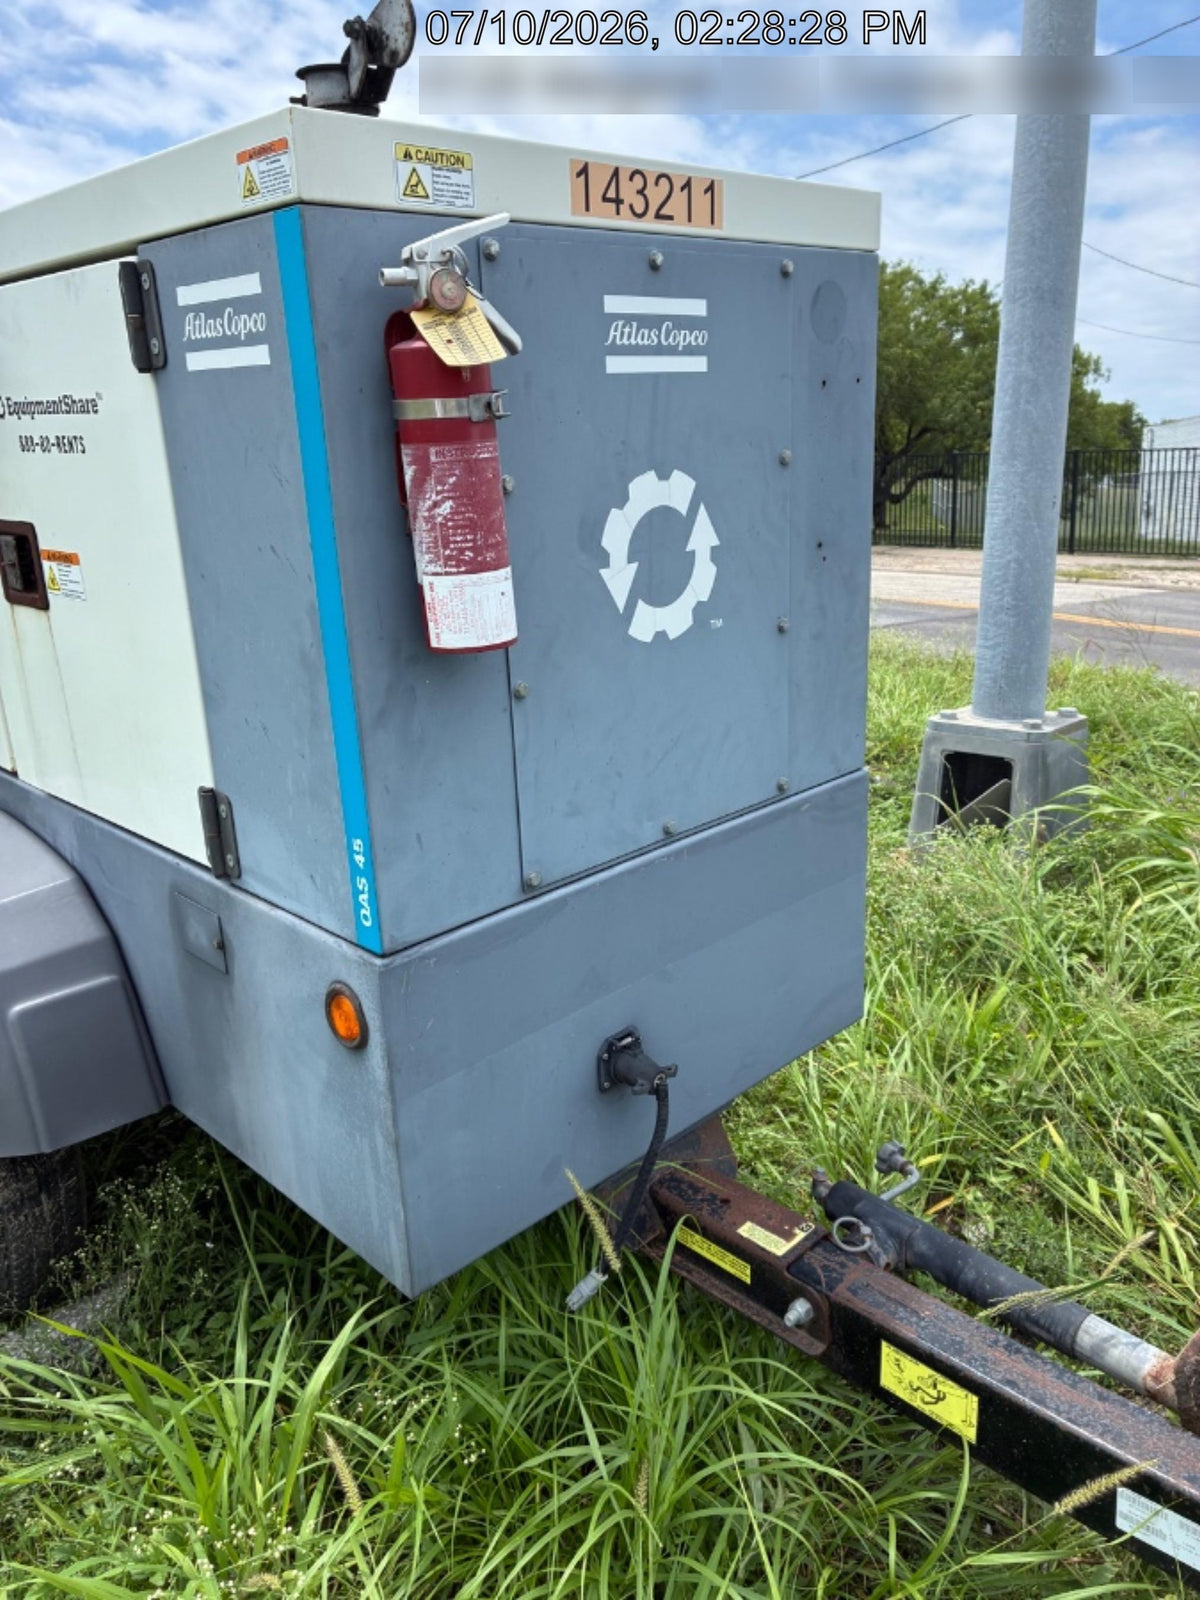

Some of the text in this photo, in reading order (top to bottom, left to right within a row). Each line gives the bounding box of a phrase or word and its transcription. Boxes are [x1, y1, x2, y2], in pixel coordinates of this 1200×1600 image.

[415, 148, 465, 168] CAUTION
[575, 161, 716, 226] 143211
[182, 307, 266, 342] Atlas Copco
[604, 319, 708, 351] Atlas Copco
[352, 838, 365, 869] 45
